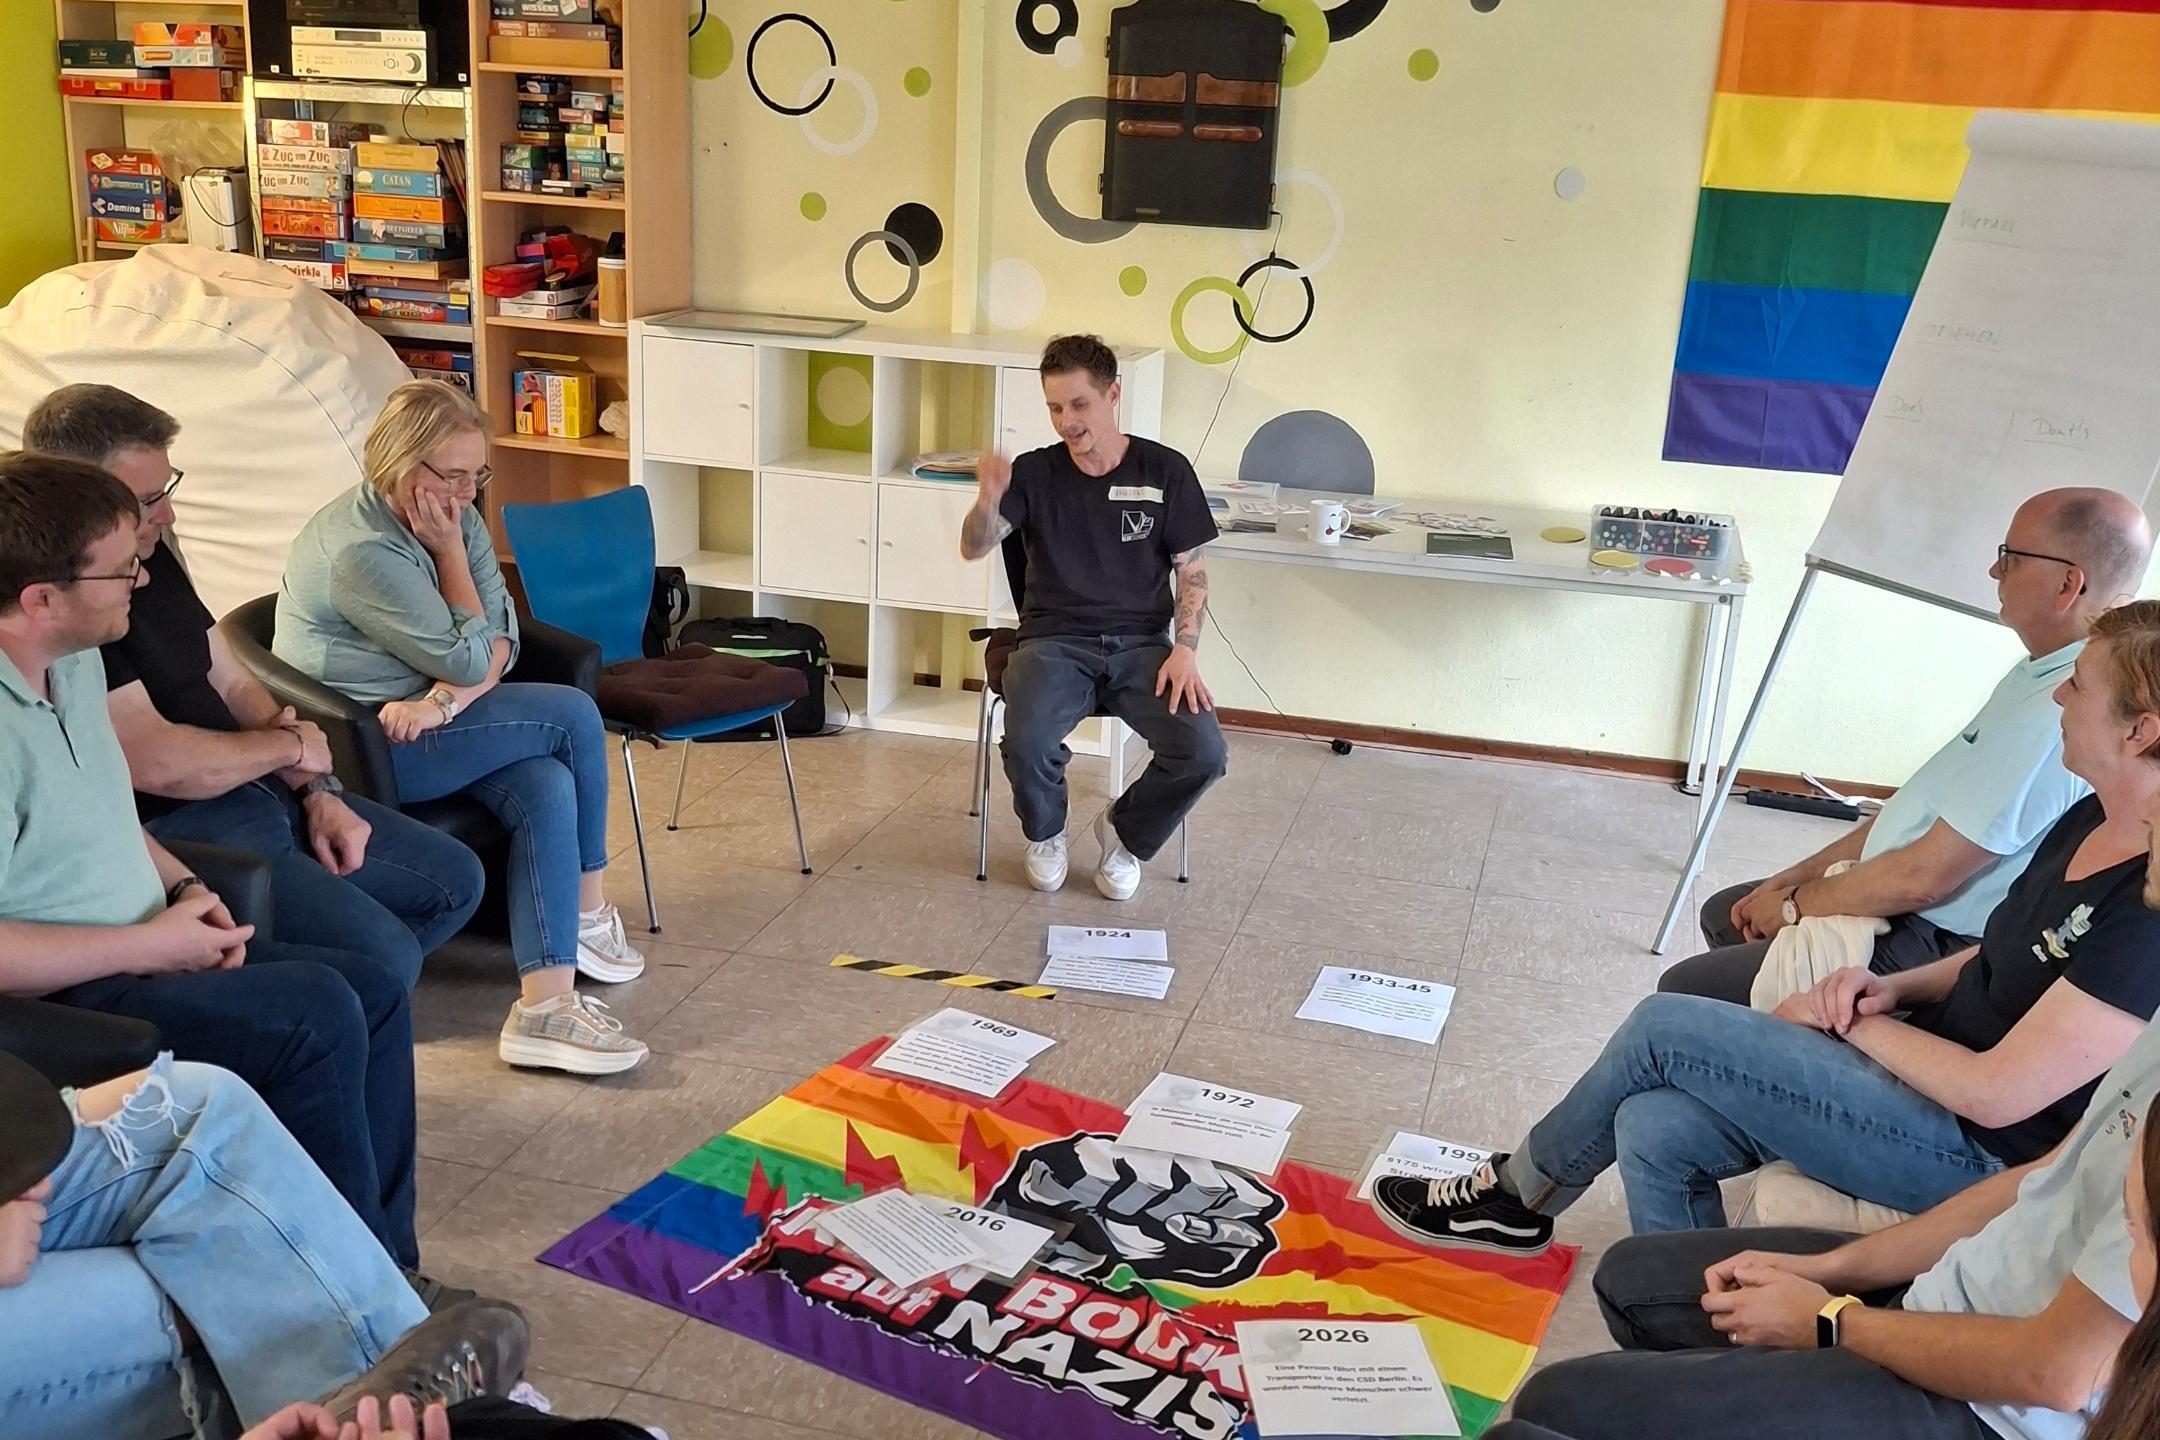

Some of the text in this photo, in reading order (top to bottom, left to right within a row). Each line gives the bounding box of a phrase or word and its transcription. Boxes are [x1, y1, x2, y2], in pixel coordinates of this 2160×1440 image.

[521, 4, 559, 12] WISSENS
[382, 174, 412, 186] CATAN
[107, 202, 141, 214] Domino
[1085, 930, 1132, 939] 1924
[1348, 972, 1432, 993] 1933-45
[971, 1019, 1018, 1038] 1969
[1201, 1088, 1256, 1109] 1972
[1438, 1146, 1481, 1162] 199
[1422, 1164, 1454, 1175] wird
[944, 1207, 1007, 1232] 2016
[1298, 1328, 1369, 1343] 2026
[933, 1299, 1241, 1440] NAZIS
[1298, 1364, 1331, 1372] Person
[1333, 1365, 1356, 1373] fährt
[1266, 1374, 1322, 1383] Transporter
[1262, 1384, 1300, 1392] werden
[1302, 1384, 1344, 1392] mehrere
[1331, 1395, 1371, 1404] verletzt.
